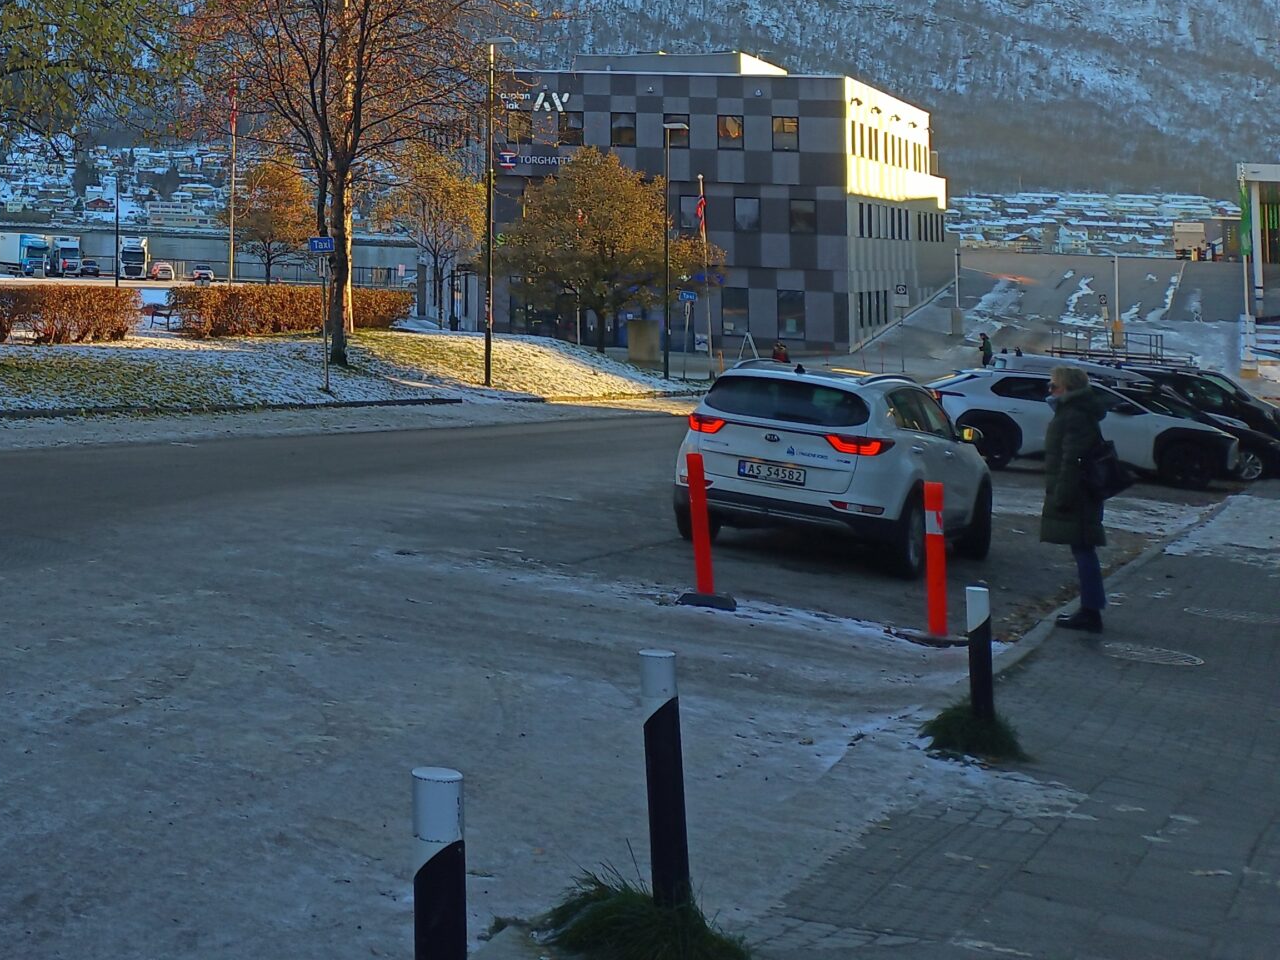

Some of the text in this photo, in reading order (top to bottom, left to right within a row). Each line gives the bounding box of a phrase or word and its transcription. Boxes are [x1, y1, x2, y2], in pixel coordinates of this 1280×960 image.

[313, 239, 331, 249] Taxi
[748, 464, 802, 481] AS 54582
